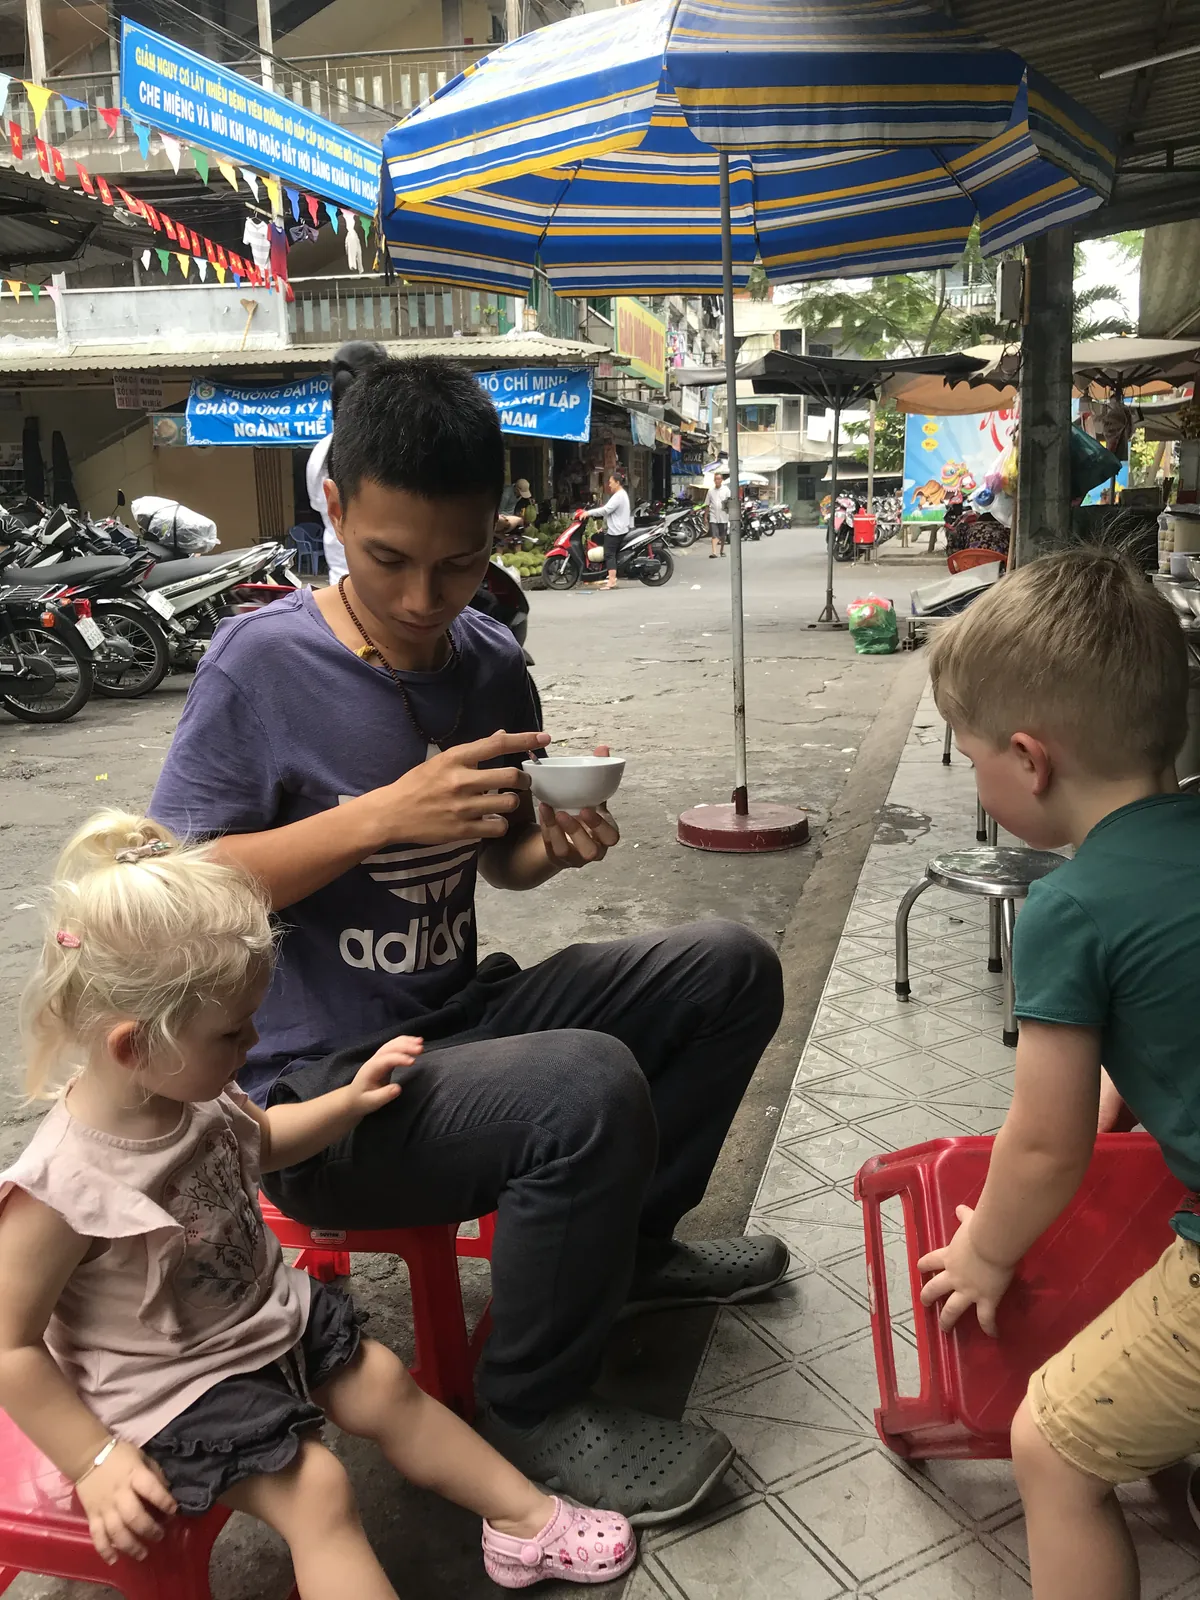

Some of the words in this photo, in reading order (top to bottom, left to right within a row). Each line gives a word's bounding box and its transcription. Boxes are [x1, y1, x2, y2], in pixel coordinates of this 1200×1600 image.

[135, 44, 156, 72] GIẢM
[157, 57, 178, 81] NGUY
[139, 80, 161, 109] CHE
[163, 91, 195, 123] MIỆNG
[196, 102, 209, 129] VÀ
[229, 119, 245, 144] KHI
[245, 126, 258, 150] HO
[258, 132, 280, 163] HOẶC
[281, 138, 297, 167] HẮT
[283, 385, 306, 399] ĐẠI
[503, 373, 529, 391] CHÍ
[532, 375, 568, 391] MINH
[195, 399, 239, 415] CHÀO
[243, 404, 291, 416] MỪNG
[295, 398, 319, 415] KỶ
[549, 390, 581, 412] LẬP
[234, 419, 291, 437] NGÀNH
[501, 410, 538, 429] NAM
[339, 906, 472, 975] adida
